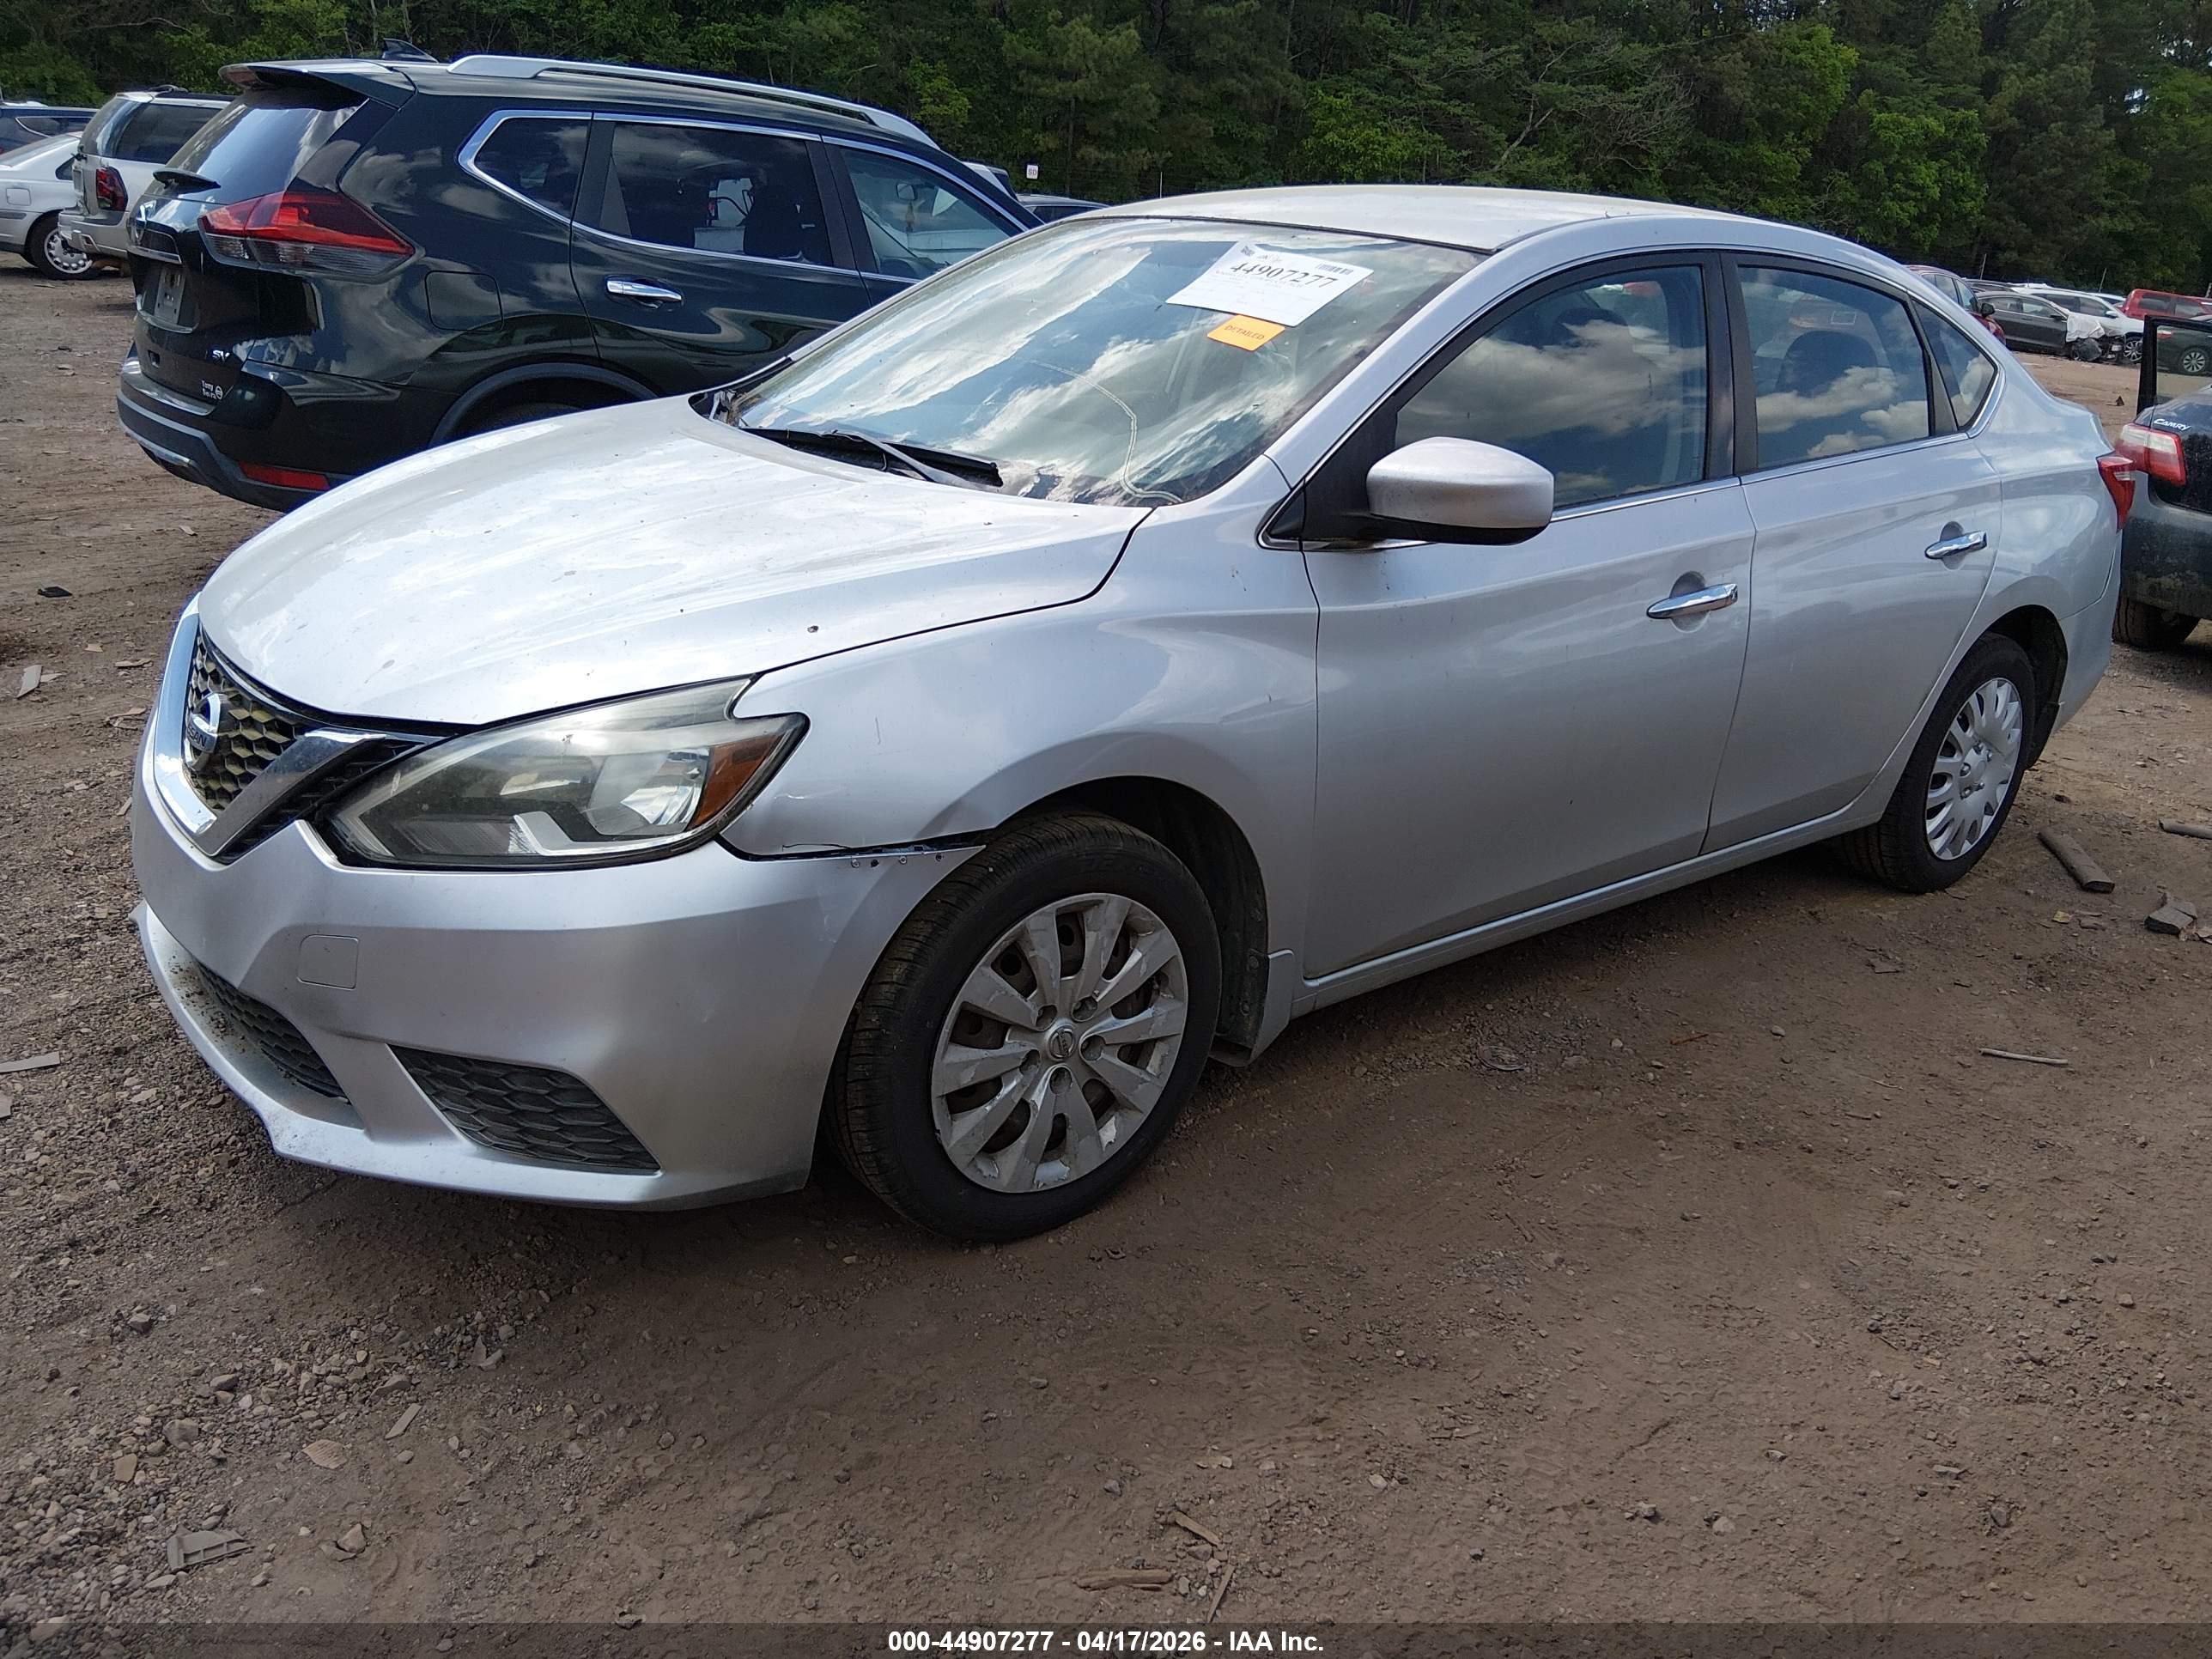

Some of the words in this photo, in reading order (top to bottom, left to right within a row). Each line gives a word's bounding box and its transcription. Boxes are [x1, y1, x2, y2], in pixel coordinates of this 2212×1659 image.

[1231, 262, 1340, 288] 44907277
[1224, 324, 1266, 341] DETAILED
[212, 349, 230, 362] SV
